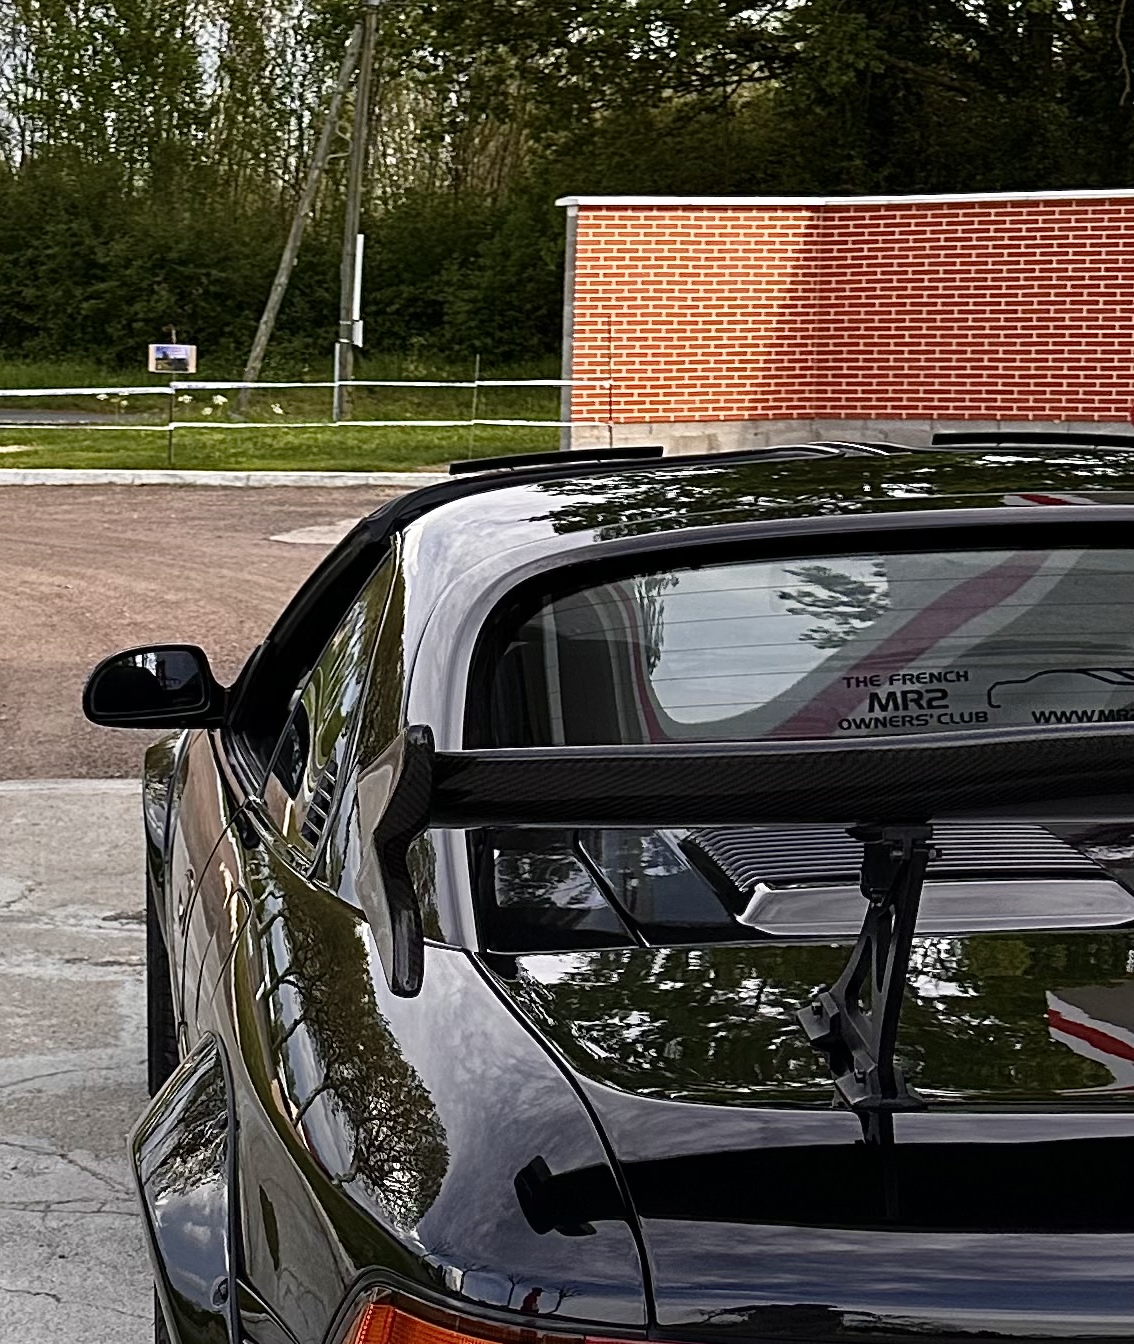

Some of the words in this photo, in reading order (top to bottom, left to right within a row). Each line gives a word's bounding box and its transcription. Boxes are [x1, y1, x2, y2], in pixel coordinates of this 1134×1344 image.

[842, 674, 881, 688] THE
[889, 670, 969, 686] FRENCH
[868, 688, 949, 713] MR2
[838, 713, 933, 730] OWNERS'
[937, 711, 988, 725] CLUB
